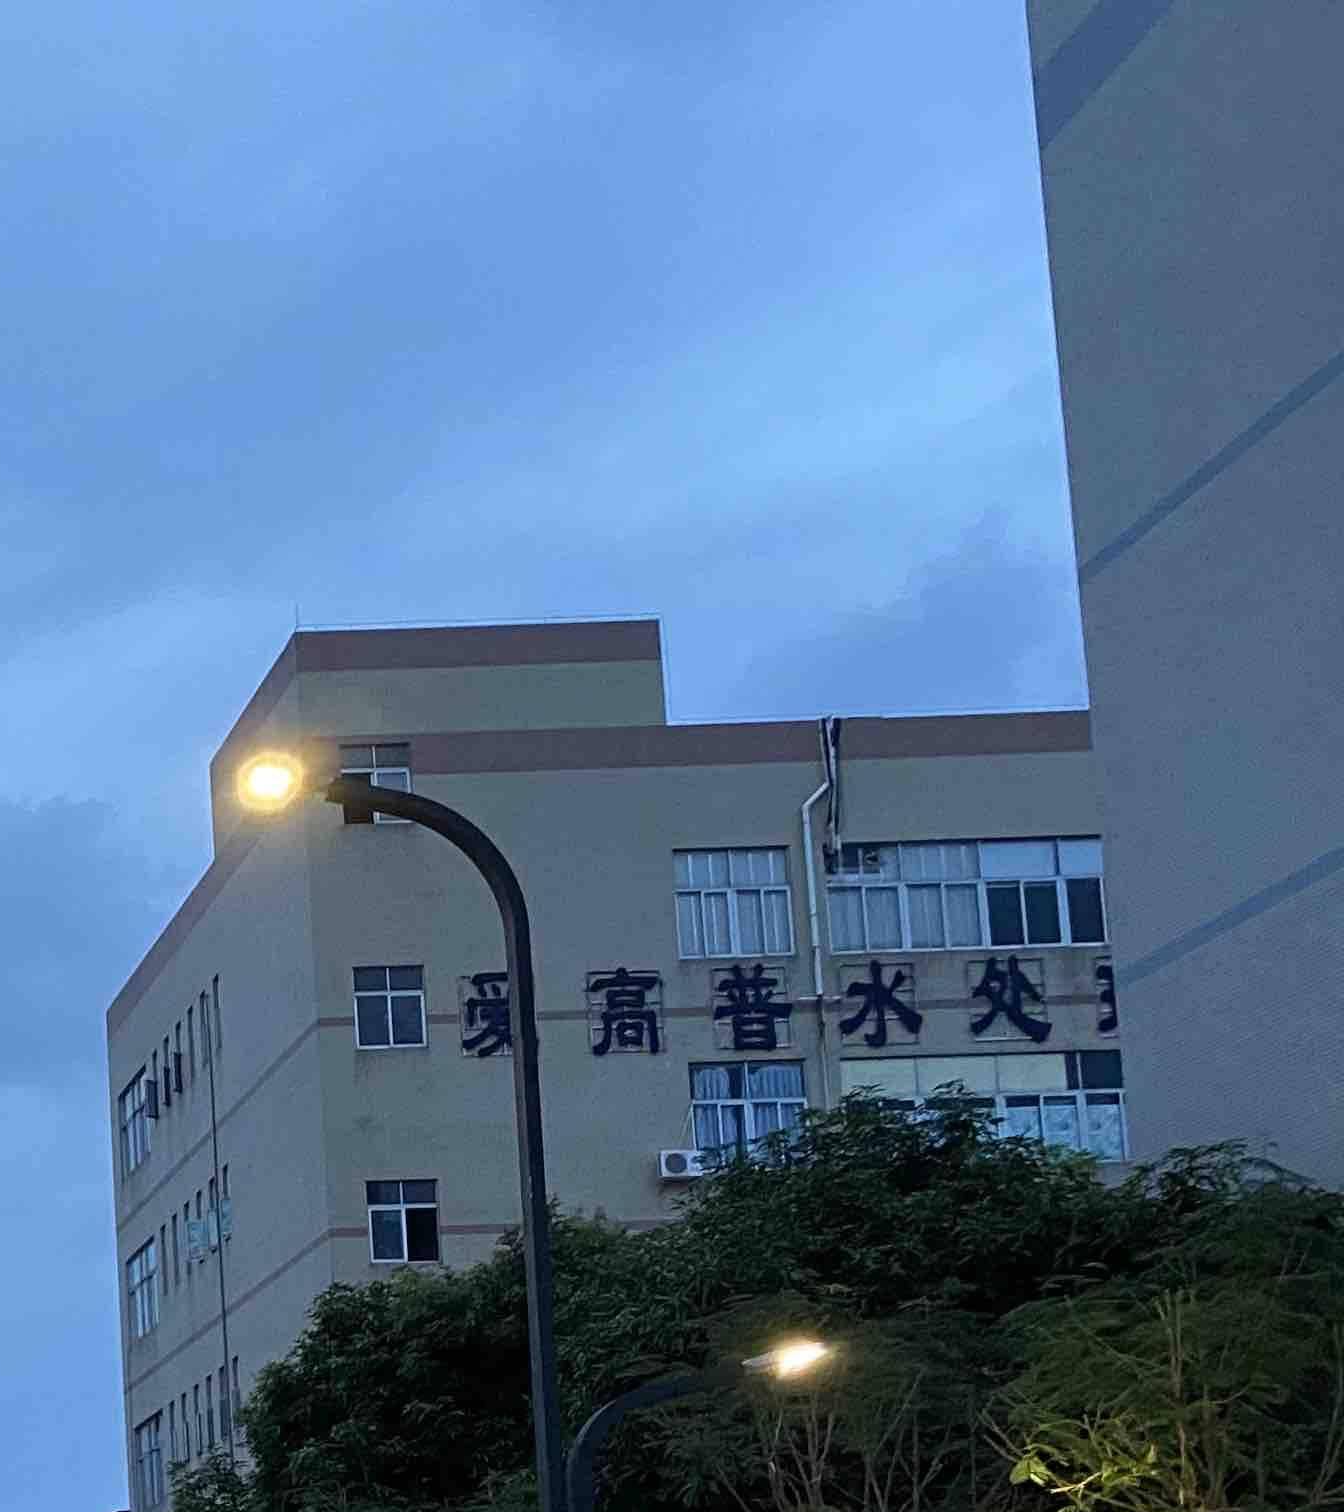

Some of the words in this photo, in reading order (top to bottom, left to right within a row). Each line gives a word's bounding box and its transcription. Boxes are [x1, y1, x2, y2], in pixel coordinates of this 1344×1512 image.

[462, 953, 1118, 1057] 爱高普水处
